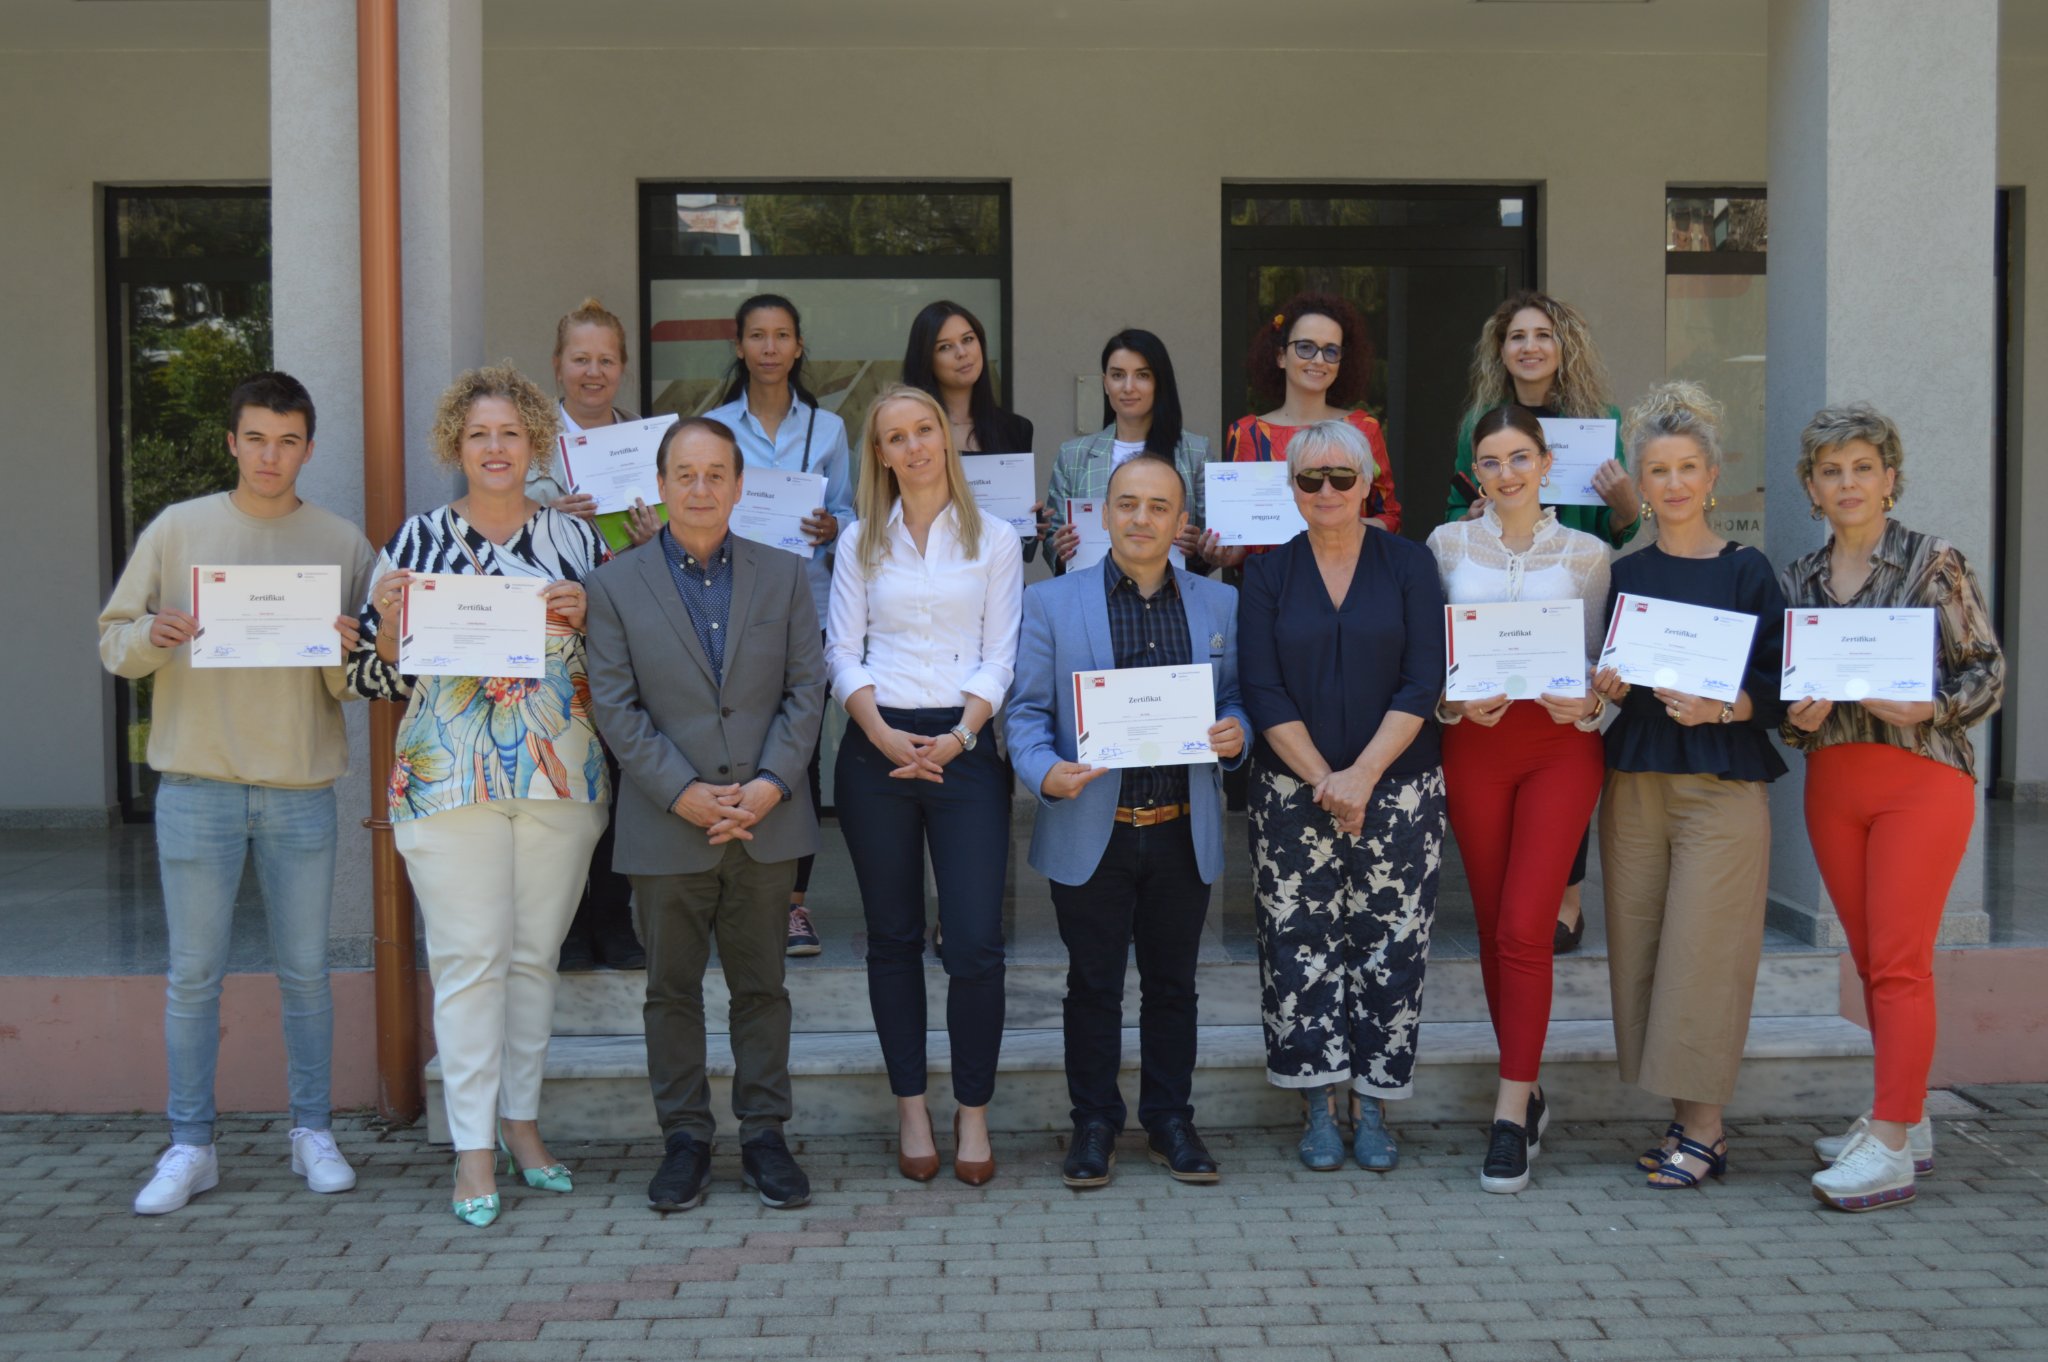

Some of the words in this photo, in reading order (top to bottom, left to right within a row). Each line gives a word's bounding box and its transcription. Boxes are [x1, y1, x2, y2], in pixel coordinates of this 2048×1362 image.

[746, 490, 774, 499] Zertifikat
[458, 603, 492, 612] Zertifikat
[1664, 628, 1697, 639] Zertifikat
[1128, 696, 1161, 704] Zertifikat
